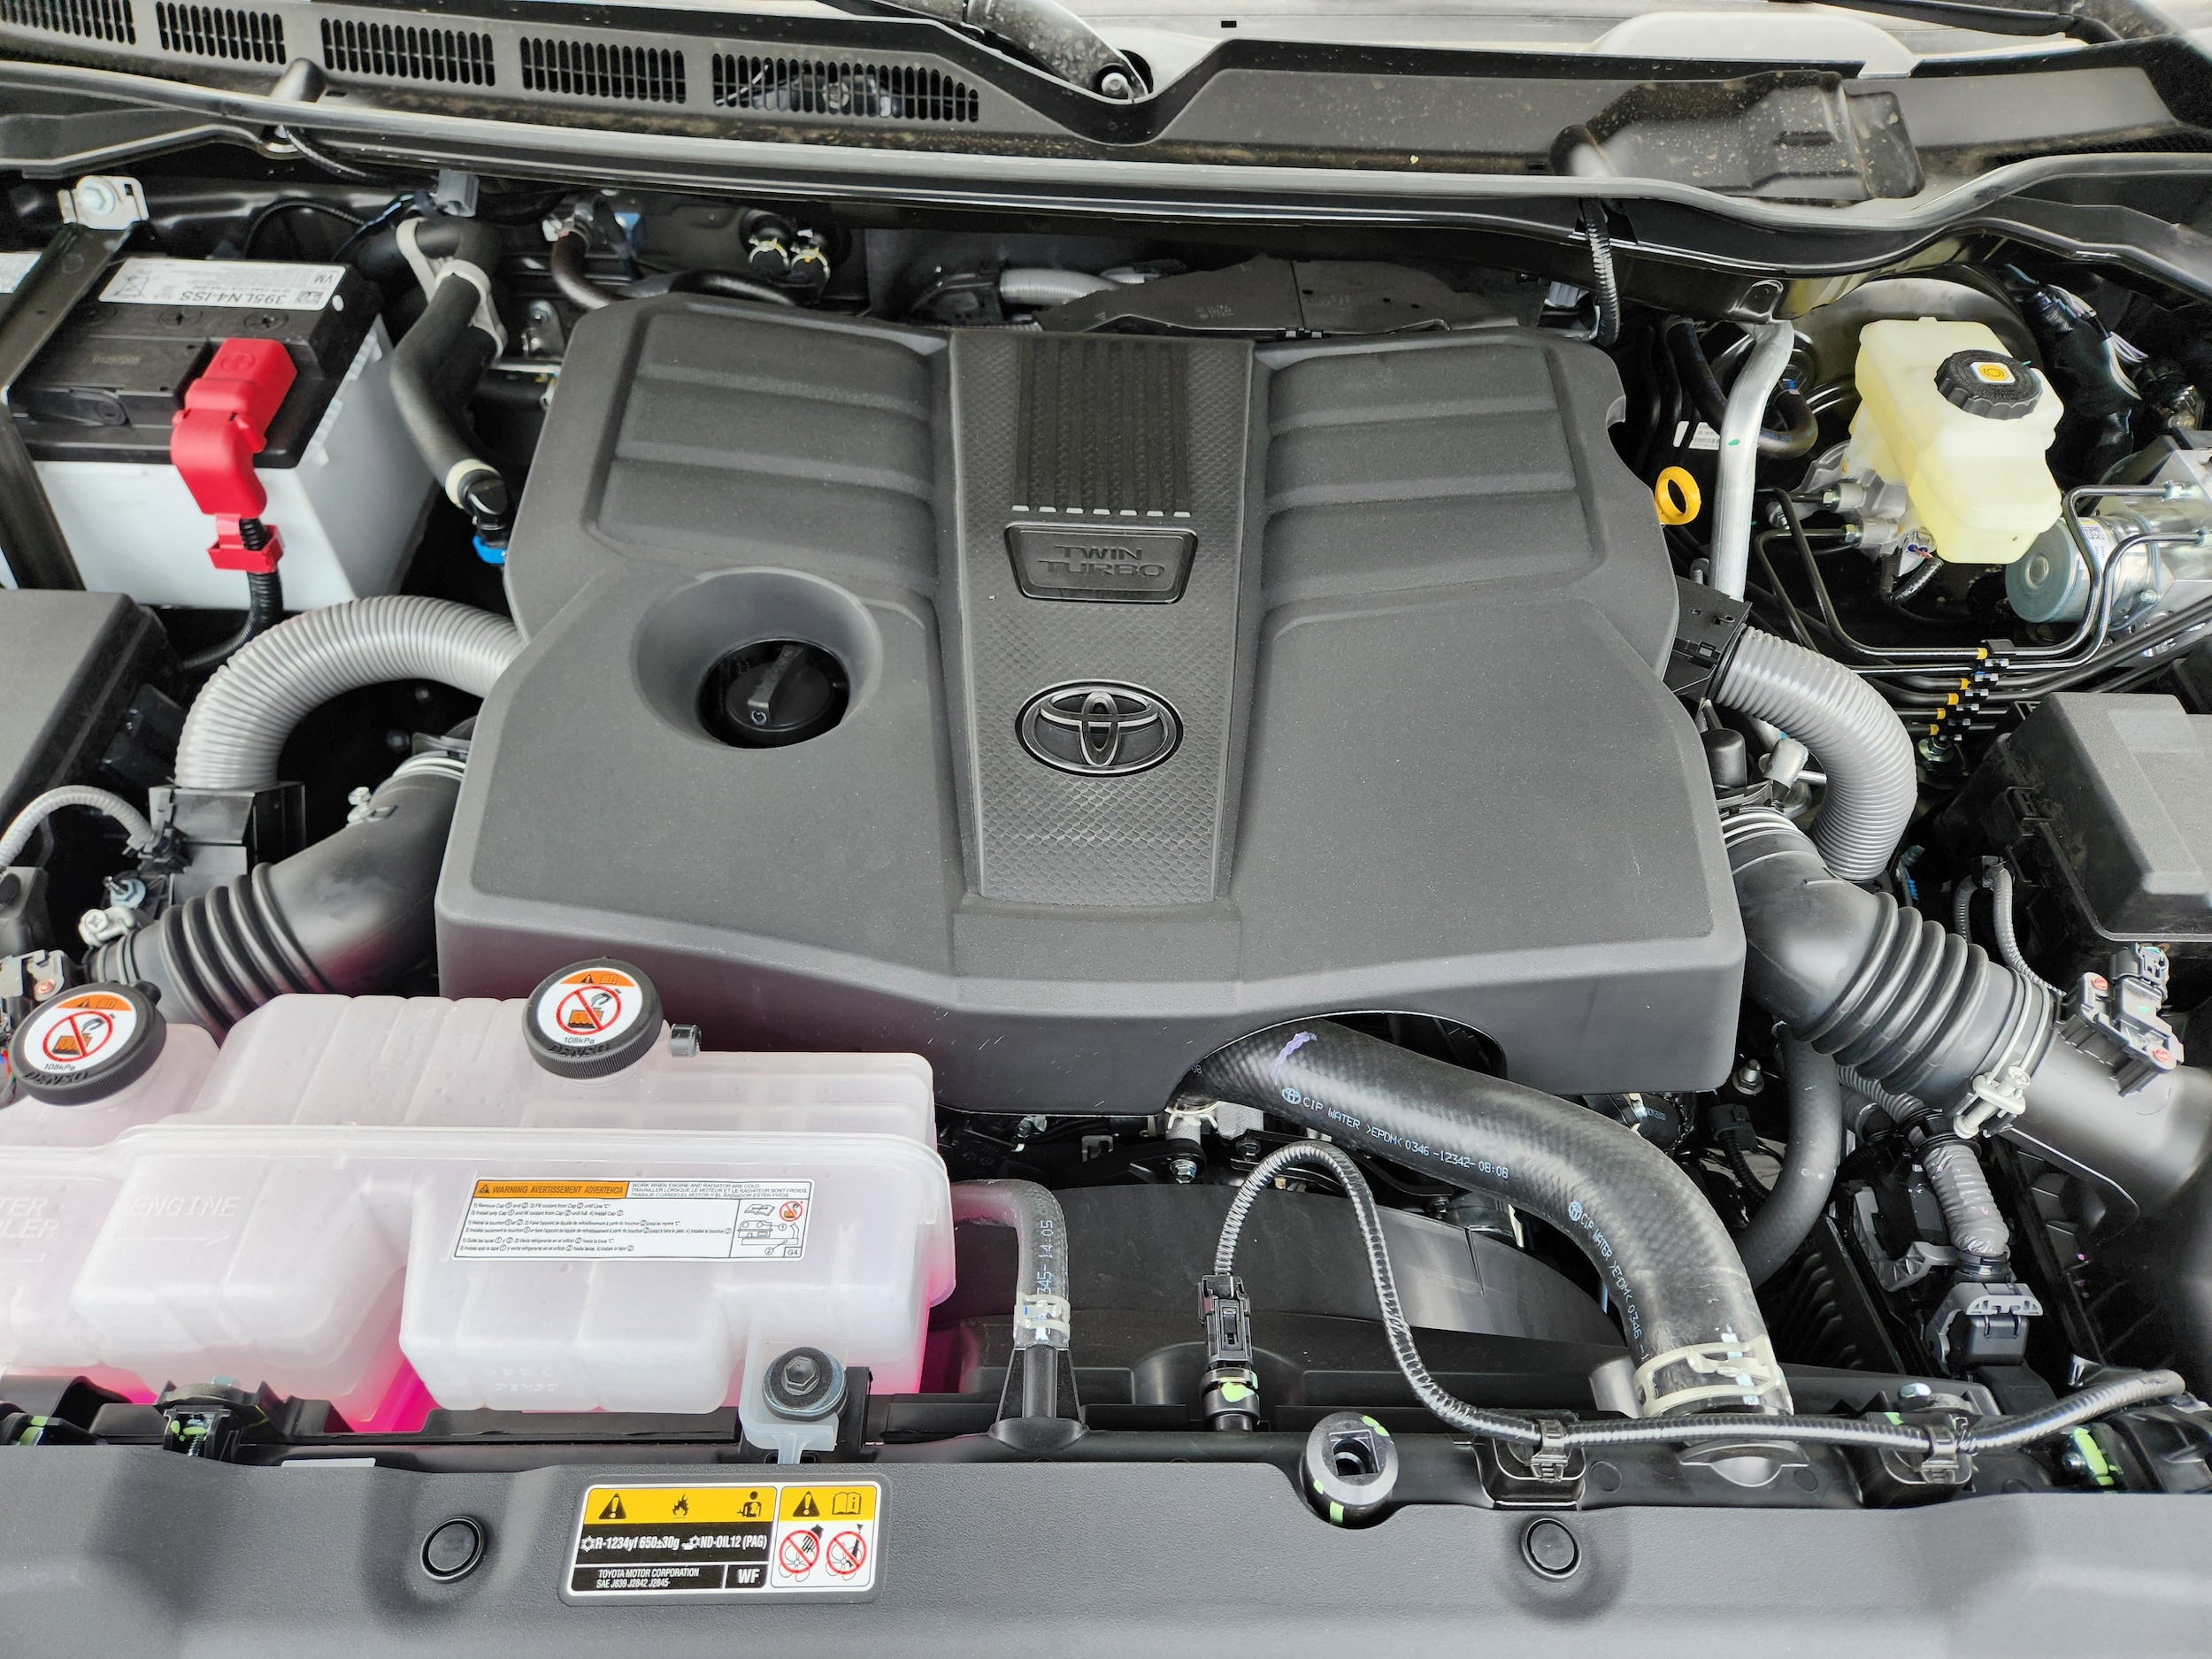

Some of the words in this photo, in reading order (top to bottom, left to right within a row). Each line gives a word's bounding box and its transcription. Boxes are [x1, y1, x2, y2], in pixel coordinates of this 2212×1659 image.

[314, 274, 335, 285] VM
[180, 290, 288, 305] 395LN4-ISS
[1054, 544, 1143, 561] TWIN
[1037, 560, 1166, 578] TURBO
[564, 1036, 595, 1045] 108kPa
[547, 1043, 611, 1058] DENSO
[43, 1063, 76, 1071] 108kPa
[23, 1070, 88, 1086] DENSO
[1302, 1097, 1324, 1111] CIP
[1327, 1106, 1361, 1130] WATER
[1404, 1140, 1430, 1156] 0346
[1478, 1160, 1509, 1179] 08:08
[0, 1196, 49, 1217] TER
[129, 1194, 242, 1217] ENGINE
[1038, 1219, 1054, 1259] 14:05
[1036, 1263, 1053, 1294] 345-
[1580, 1213, 1594, 1229] CIP
[1592, 1228, 1612, 1261] WATER
[1627, 1305, 1642, 1340] 0346
[595, 1535, 639, 1552] R-1234yf
[639, 1535, 680, 1551] 650±30g
[699, 1535, 742, 1548] ND-OIL12
[742, 1534, 767, 1550] (PAG)
[598, 1569, 625, 1578] TOYOTA
[625, 1569, 650, 1578] MOTOR
[651, 1567, 700, 1578] CORPORATION
[737, 1569, 760, 1584] WF
[595, 1579, 611, 1588] SAE
[611, 1578, 627, 1588] J639
[628, 1578, 649, 1587] J2842
